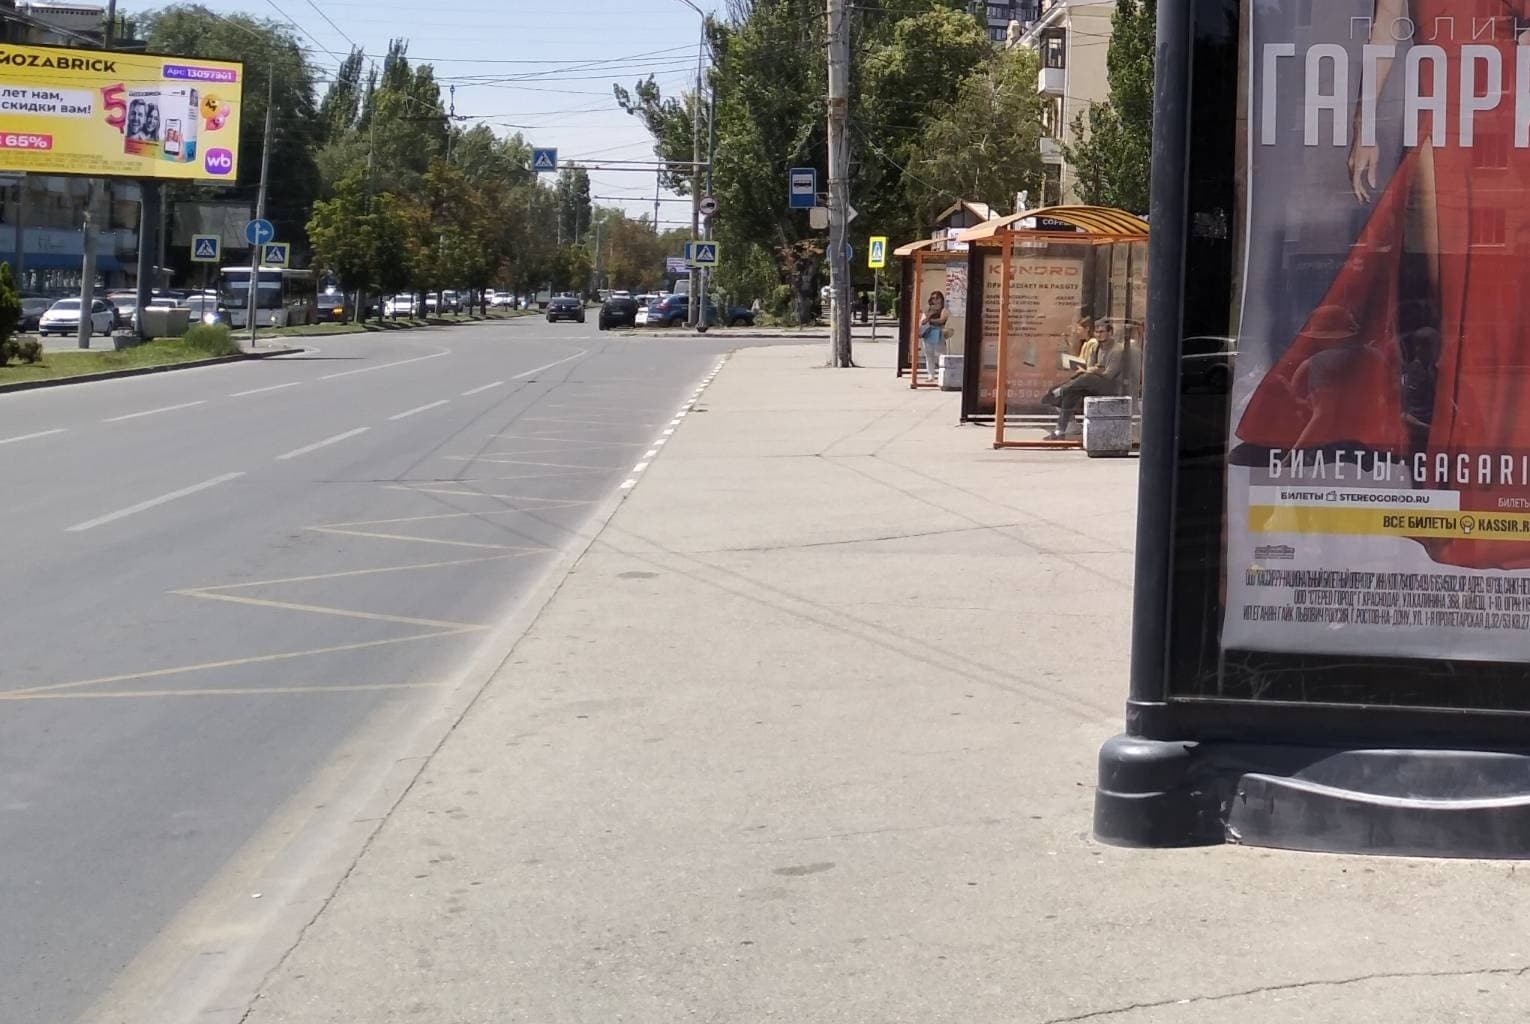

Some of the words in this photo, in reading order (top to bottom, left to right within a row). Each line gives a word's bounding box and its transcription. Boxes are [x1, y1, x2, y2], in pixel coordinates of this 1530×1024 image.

[2, 89, 27, 98] лет
[31, 91, 63, 102] нам,
[1, 101, 56, 113] скидки
[60, 104, 91, 114] вам!
[5, 134, 48, 149] 65%
[1280, 492, 1323, 501] БИЛЕТЫ
[1339, 493, 1430, 504] STEREOGOROD.RU
[1383, 515, 1405, 528] ВСЕ
[1408, 516, 1457, 530] БИЛЕТЫ
